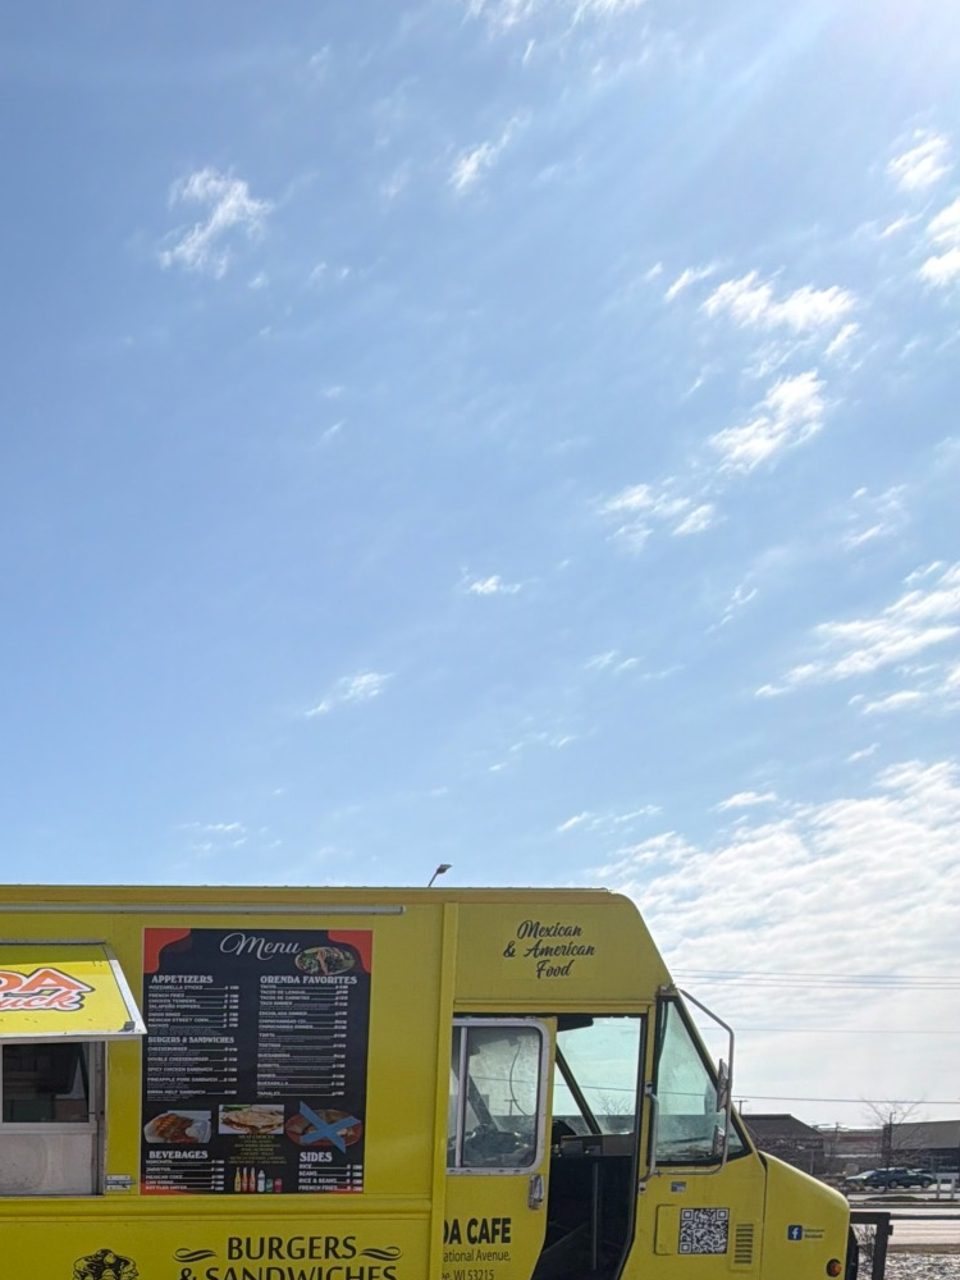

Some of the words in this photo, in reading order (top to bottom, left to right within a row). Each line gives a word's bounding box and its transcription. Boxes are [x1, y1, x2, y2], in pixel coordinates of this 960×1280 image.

[517, 920, 582, 939] Mexican
[219, 932, 301, 960] Menu
[503, 940, 516, 957] &
[523, 939, 595, 958] American
[536, 959, 575, 979] Food
[151, 975, 214, 984] APPETIZERS
[260, 975, 301, 984] ORENDA
[302, 976, 358, 984] FAVORITES
[148, 1150, 209, 1159] BEVERAGES
[299, 1151, 333, 1162] SIDES
[466, 1217, 512, 1245] CAFE
[227, 1236, 357, 1260] BURGERS
[442, 1249, 475, 1263] ational
